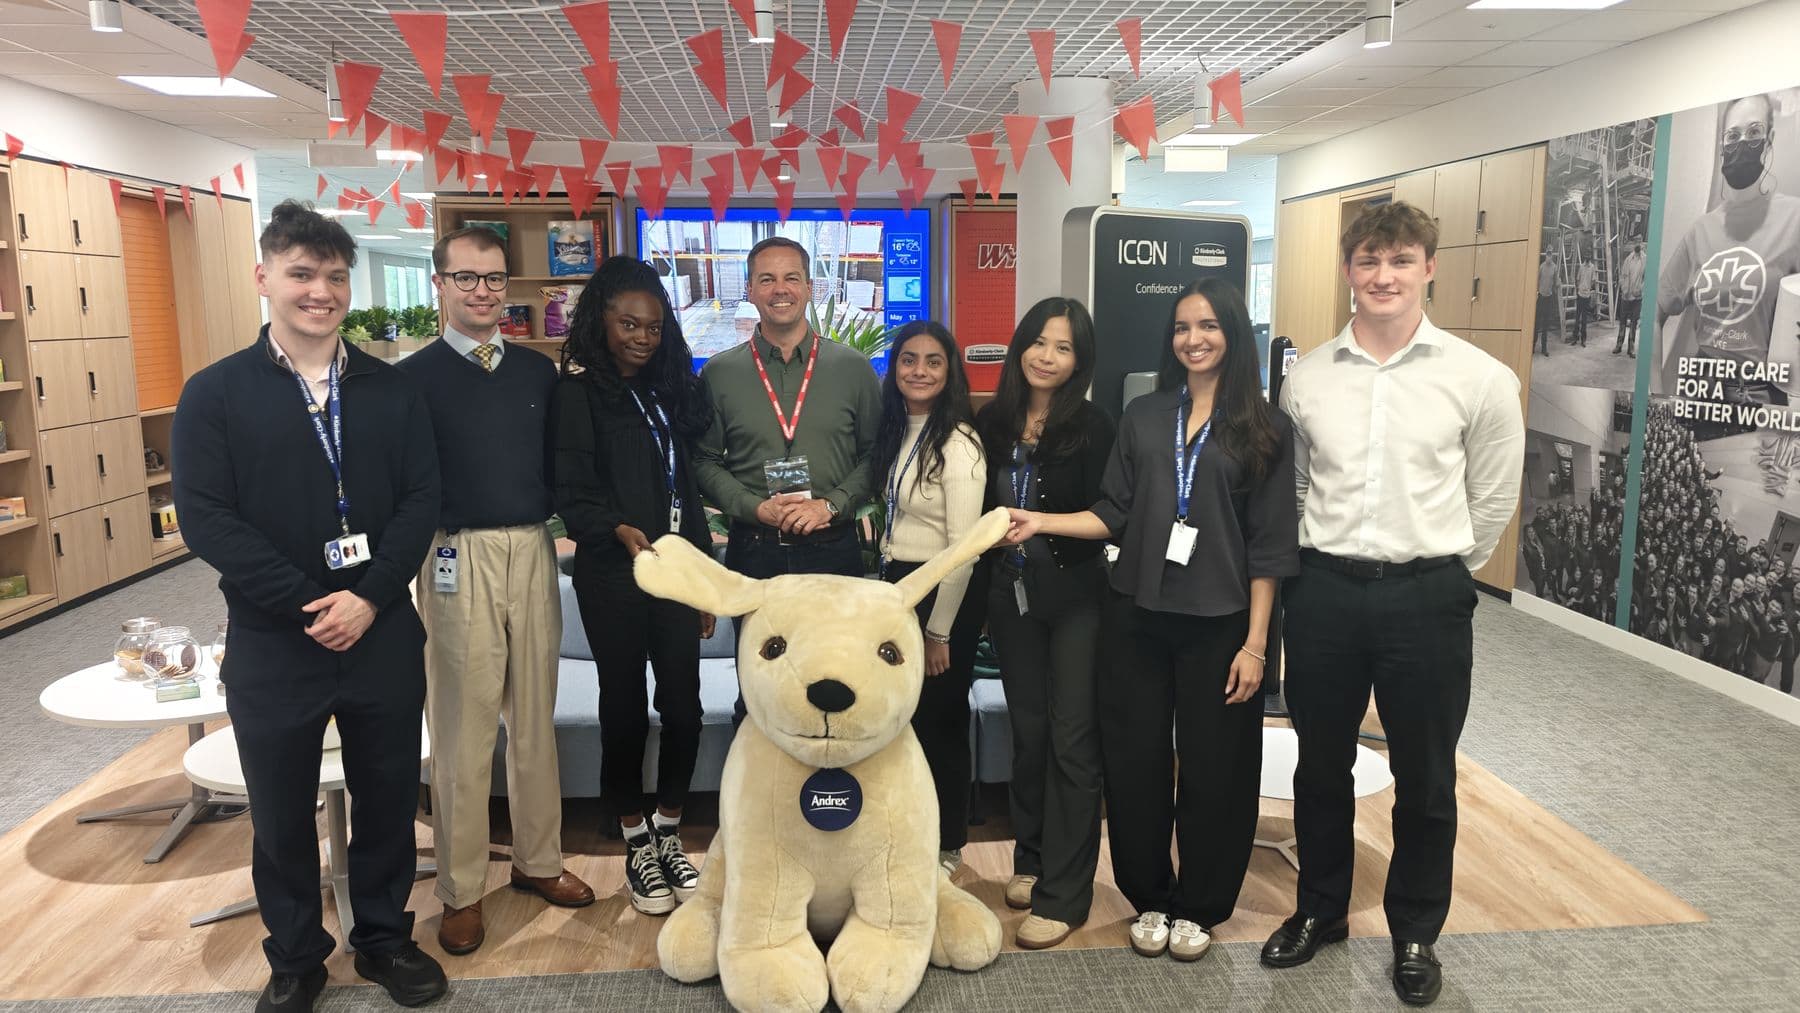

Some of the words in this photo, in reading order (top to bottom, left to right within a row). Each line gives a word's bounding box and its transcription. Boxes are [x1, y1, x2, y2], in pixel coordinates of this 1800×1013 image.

[1118, 239, 1168, 265] ICON
[1136, 283, 1178, 294] Confidence
[1678, 357, 1737, 378] BETTER
[1741, 361, 1790, 383] CARE
[1676, 378, 1708, 399] FOR
[1712, 381, 1724, 400] A
[1674, 400, 1732, 423] BETTER
[1737, 406, 1800, 432] WORLD
[811, 794, 848, 806] Andrex
